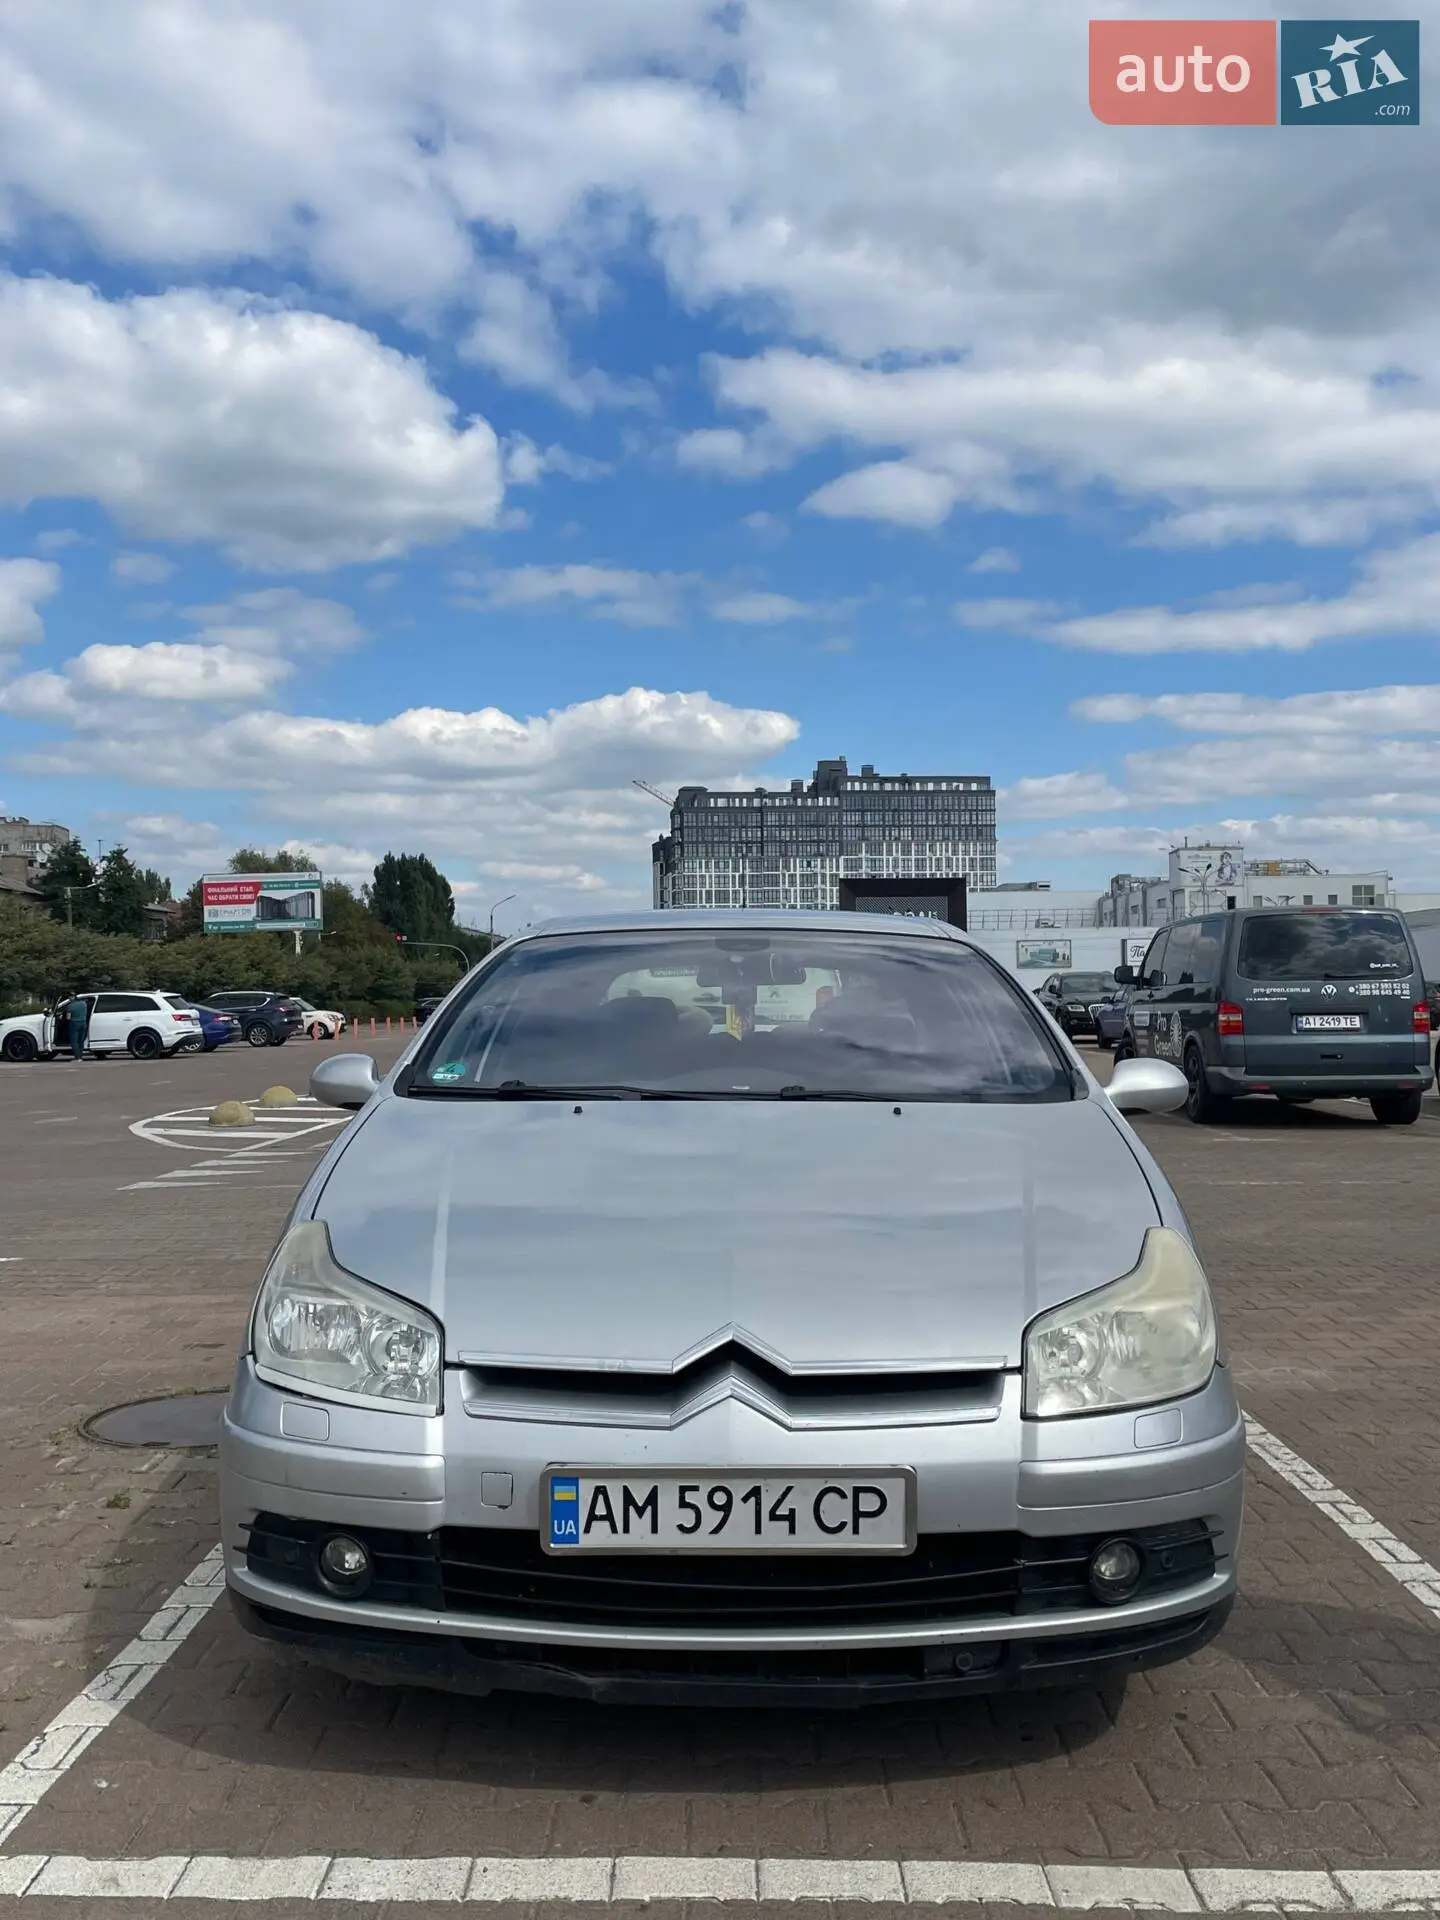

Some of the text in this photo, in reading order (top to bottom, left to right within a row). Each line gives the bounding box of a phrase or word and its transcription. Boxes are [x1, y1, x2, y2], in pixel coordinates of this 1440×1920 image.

[1319, 1016, 1341, 1027] 2419
[1342, 1016, 1358, 1027] TE
[583, 1484, 888, 1536] AM 5914 CP
[553, 1518, 578, 1536] UA
